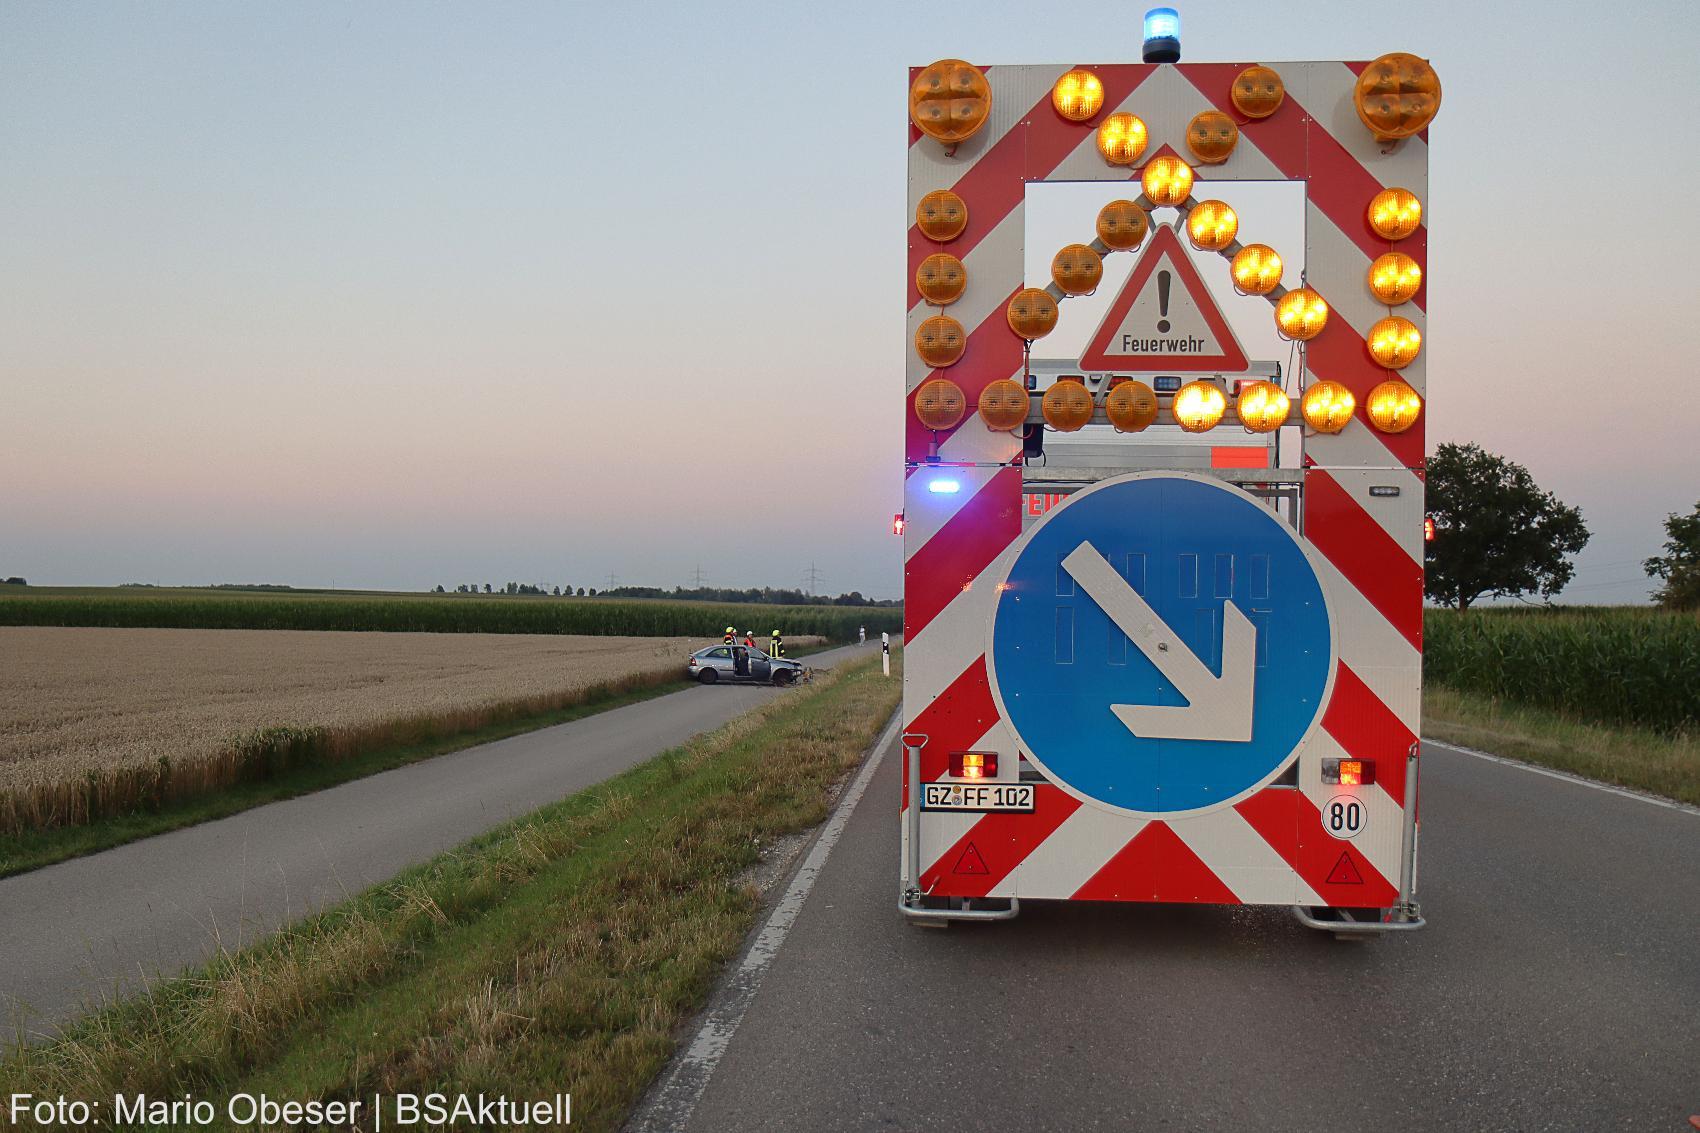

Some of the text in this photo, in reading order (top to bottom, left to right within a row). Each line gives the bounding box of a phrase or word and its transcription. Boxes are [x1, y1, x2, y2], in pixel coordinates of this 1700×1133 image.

[1123, 335, 1204, 352] Feuerwehr
[926, 787, 1030, 806] GZ FF 102
[1331, 802, 1359, 831] 80
